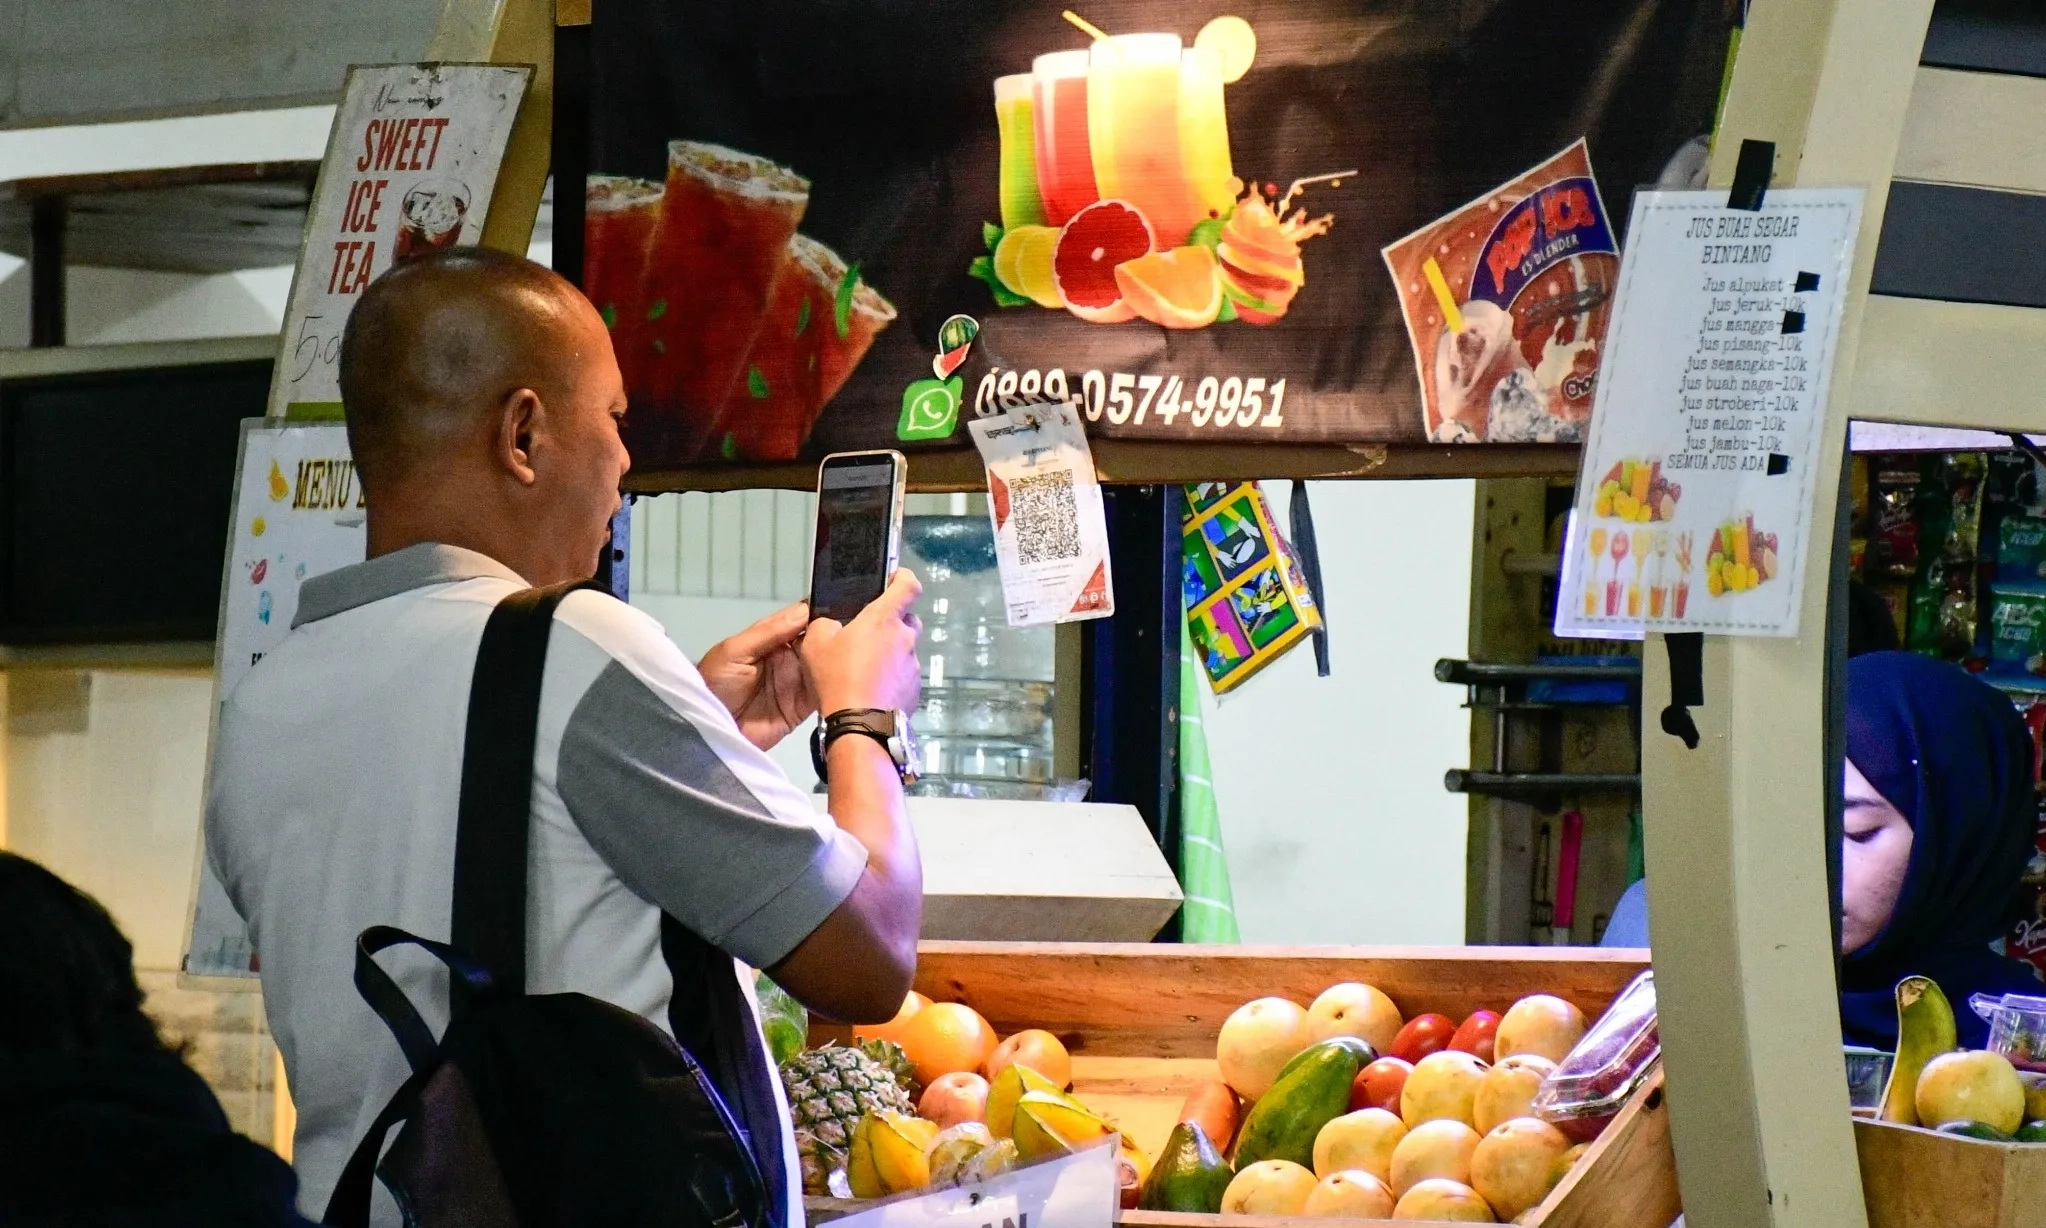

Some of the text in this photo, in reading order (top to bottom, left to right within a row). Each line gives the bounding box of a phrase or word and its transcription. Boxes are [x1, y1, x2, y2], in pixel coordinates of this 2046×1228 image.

[357, 118, 449, 171] SWEET
[340, 180, 388, 233] ICE
[1686, 216, 1799, 238] JUS BUAH SEGAR
[1701, 245, 1772, 264] BINTANG
[327, 241, 375, 294] TEA
[1702, 278, 1726, 292] Jus
[1729, 278, 1784, 295] alpukat
[1708, 297, 1806, 315] jus jeruk-10k
[1699, 317, 1722, 334] jus
[1696, 336, 1803, 355] jus pisang-10k
[1685, 356, 1808, 375] jus semangka-10k
[1678, 375, 1807, 395] jus buah naga-10k
[1680, 396, 1799, 413] jus stroberi-10k
[1686, 415, 1786, 433] jus melon-10k
[1684, 435, 1782, 453] jus jambu-10k
[1667, 454, 1708, 470] SEMUA
[1713, 455, 1737, 470] JUS
[1740, 455, 1764, 471] ADA
[292, 459, 356, 509] MENU
